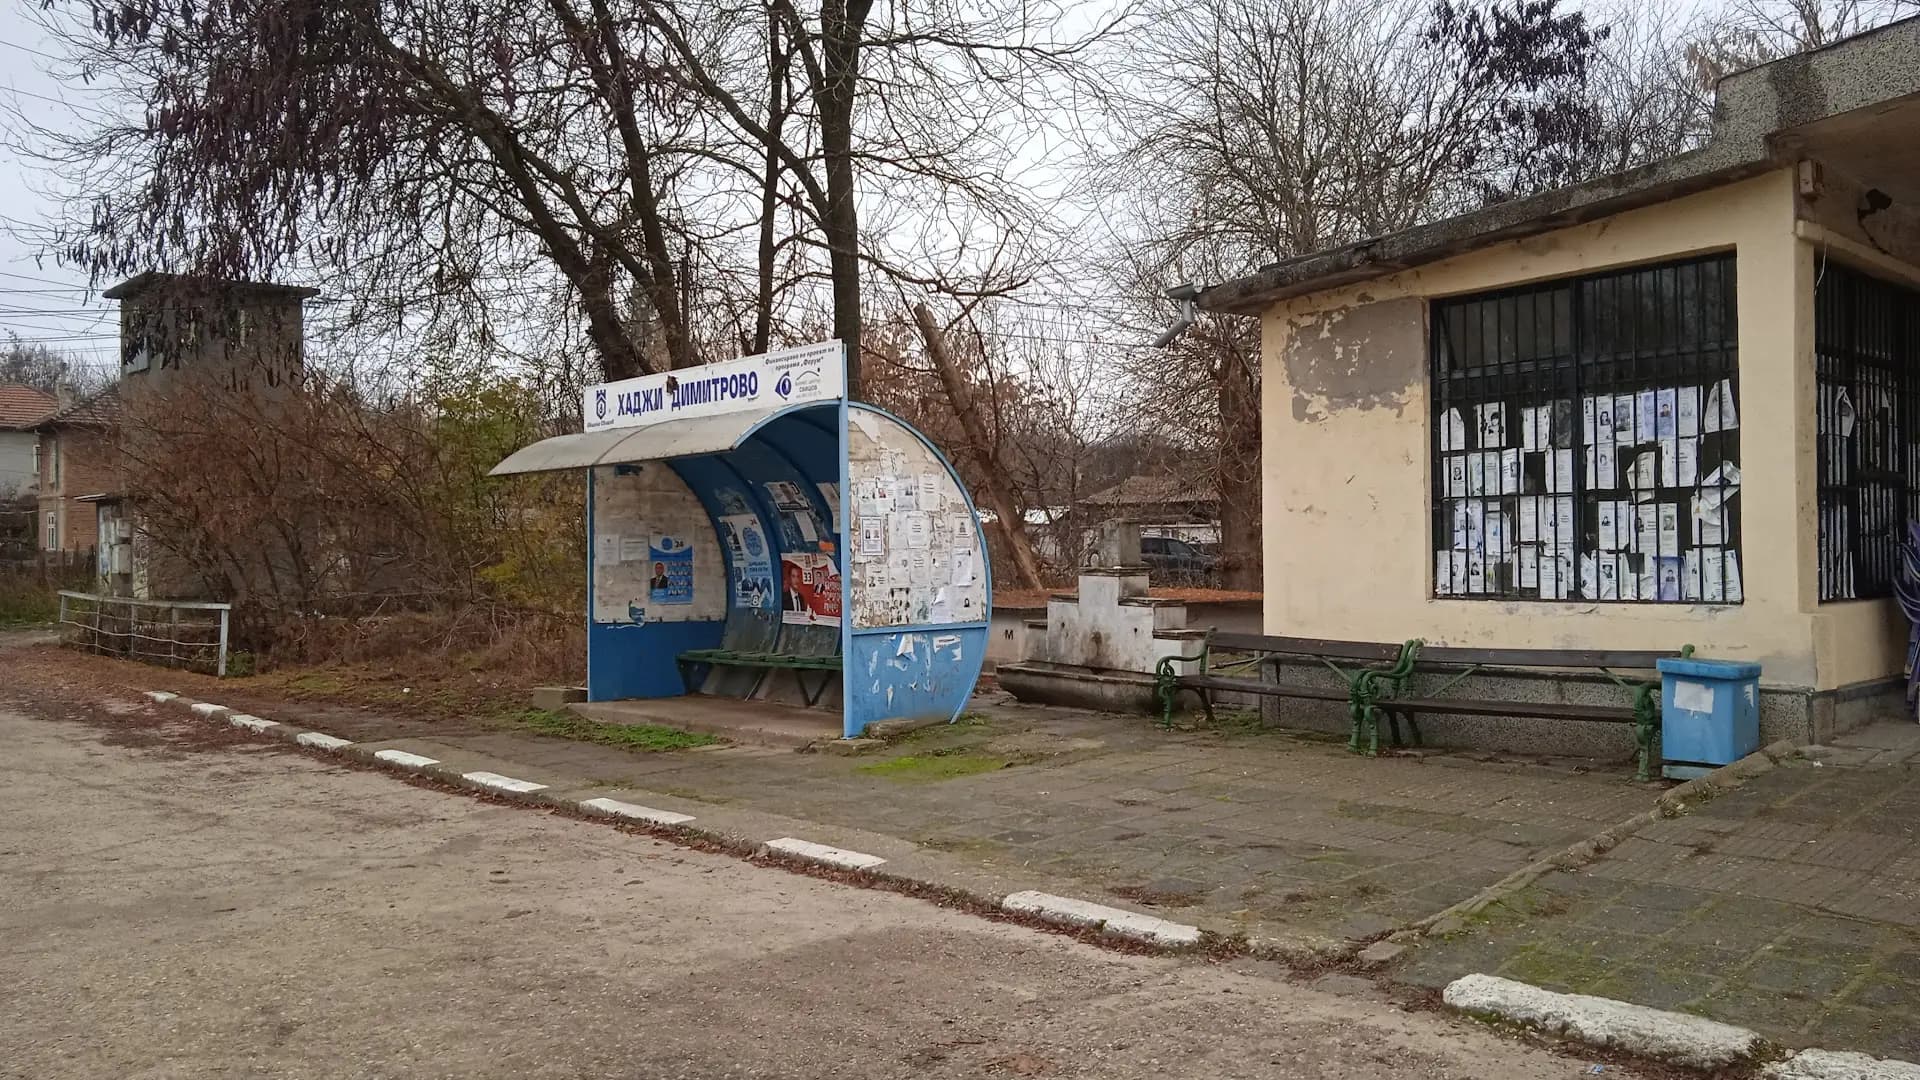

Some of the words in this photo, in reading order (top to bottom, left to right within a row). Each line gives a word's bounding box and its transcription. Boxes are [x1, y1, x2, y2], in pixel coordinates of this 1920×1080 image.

[617, 387, 663, 417] ХАДЖИ
[671, 371, 758, 412] ДИМИТРОВО
[803, 572, 812, 582] 33
